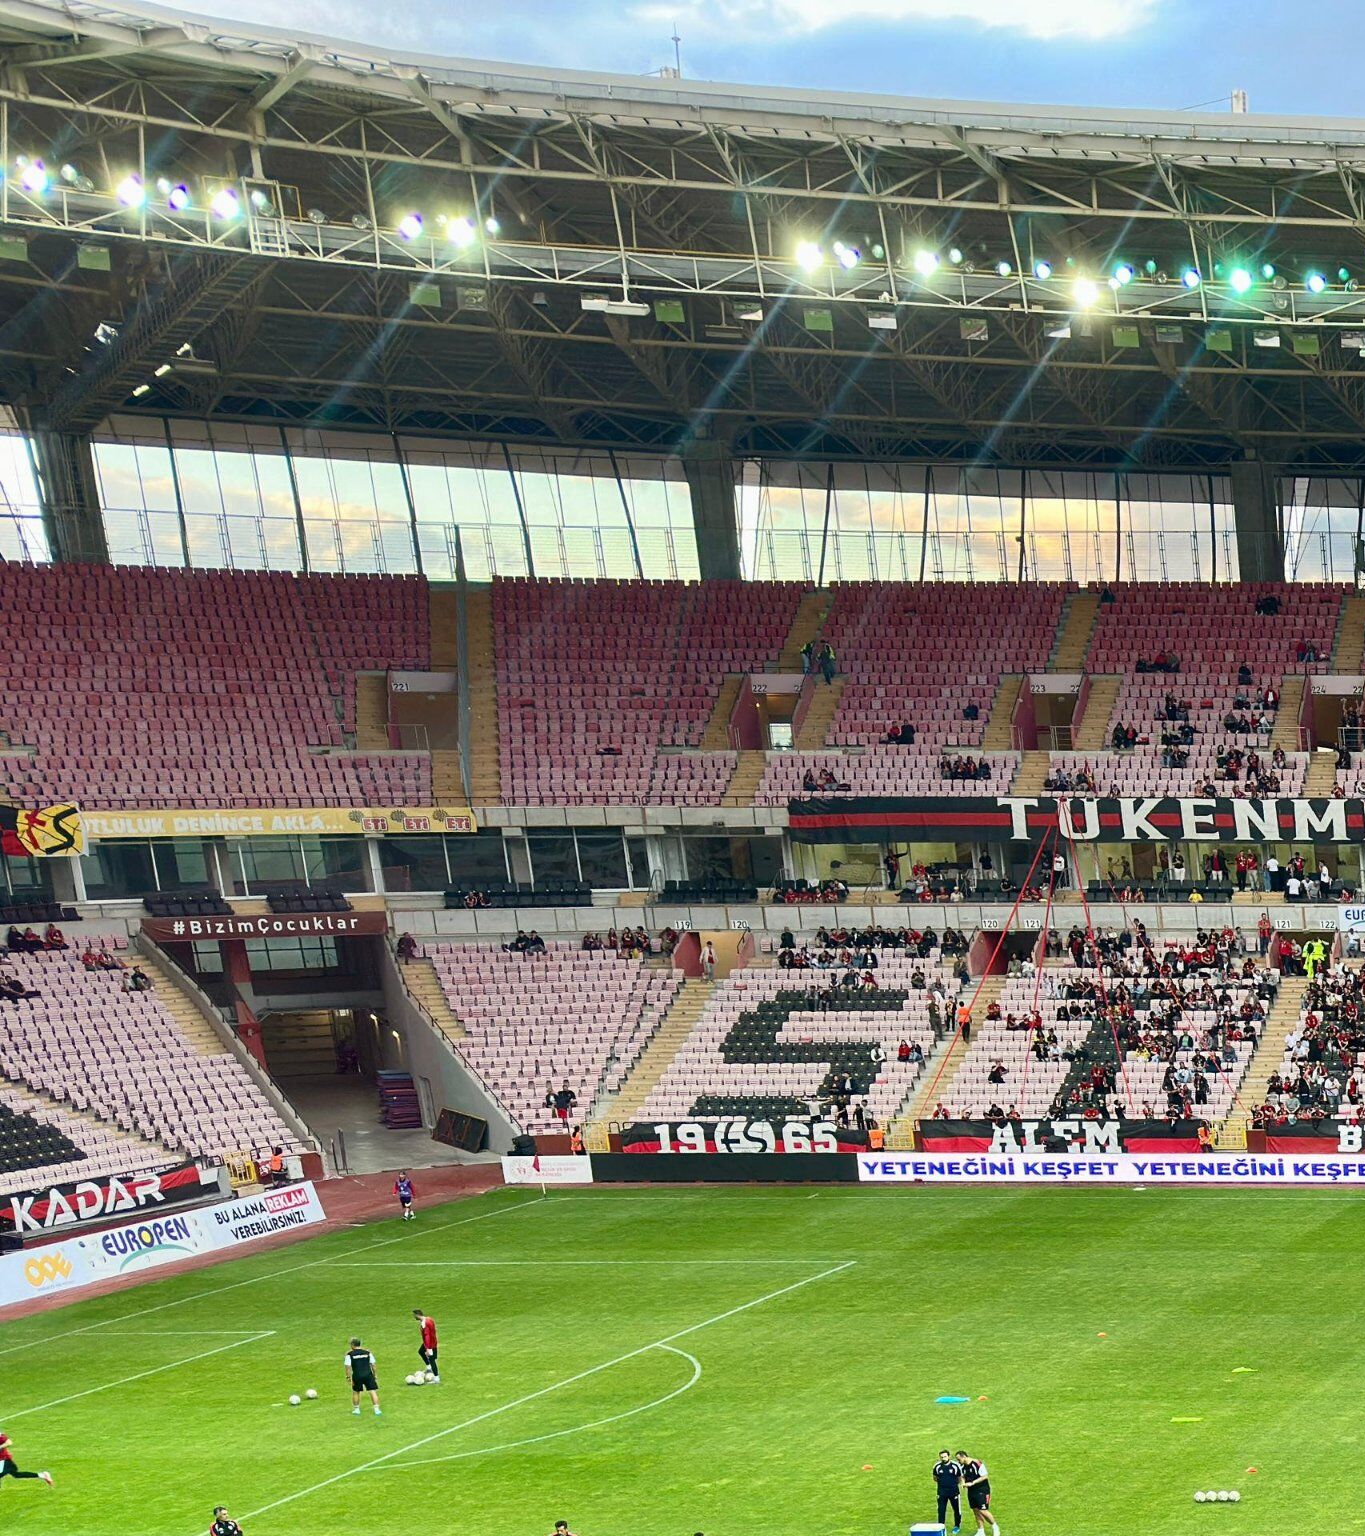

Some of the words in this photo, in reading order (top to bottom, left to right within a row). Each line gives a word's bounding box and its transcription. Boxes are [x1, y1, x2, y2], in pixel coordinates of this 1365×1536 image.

[84, 814, 164, 834] TLULUK
[174, 811, 265, 832] DENİNCE
[172, 914, 359, 936] #BizimÇocuklar
[675, 920, 691, 929] 119
[732, 920, 747, 929] 120
[983, 919, 998, 928] 120
[1025, 919, 1041, 928] 121
[1276, 920, 1291, 929] 121
[1320, 920, 1335, 929] 122
[655, 1123, 706, 1154] 19
[784, 1122, 838, 1154] 65
[988, 1121, 1121, 1154] ALEM
[863, 1157, 1015, 1177] YETENEĞİNİ
[1023, 1161, 1118, 1179] KEŞFET
[1134, 1158, 1286, 1178] YETENEĞİNİ
[11, 1172, 166, 1233] KADAR
[214, 1211, 229, 1224] BU
[232, 1201, 266, 1221] ALANA
[268, 1190, 308, 1211] REKLAM
[102, 1217, 191, 1256] EUROPEN
[230, 1211, 307, 1240] VEREBİLİRSİNİZ!
